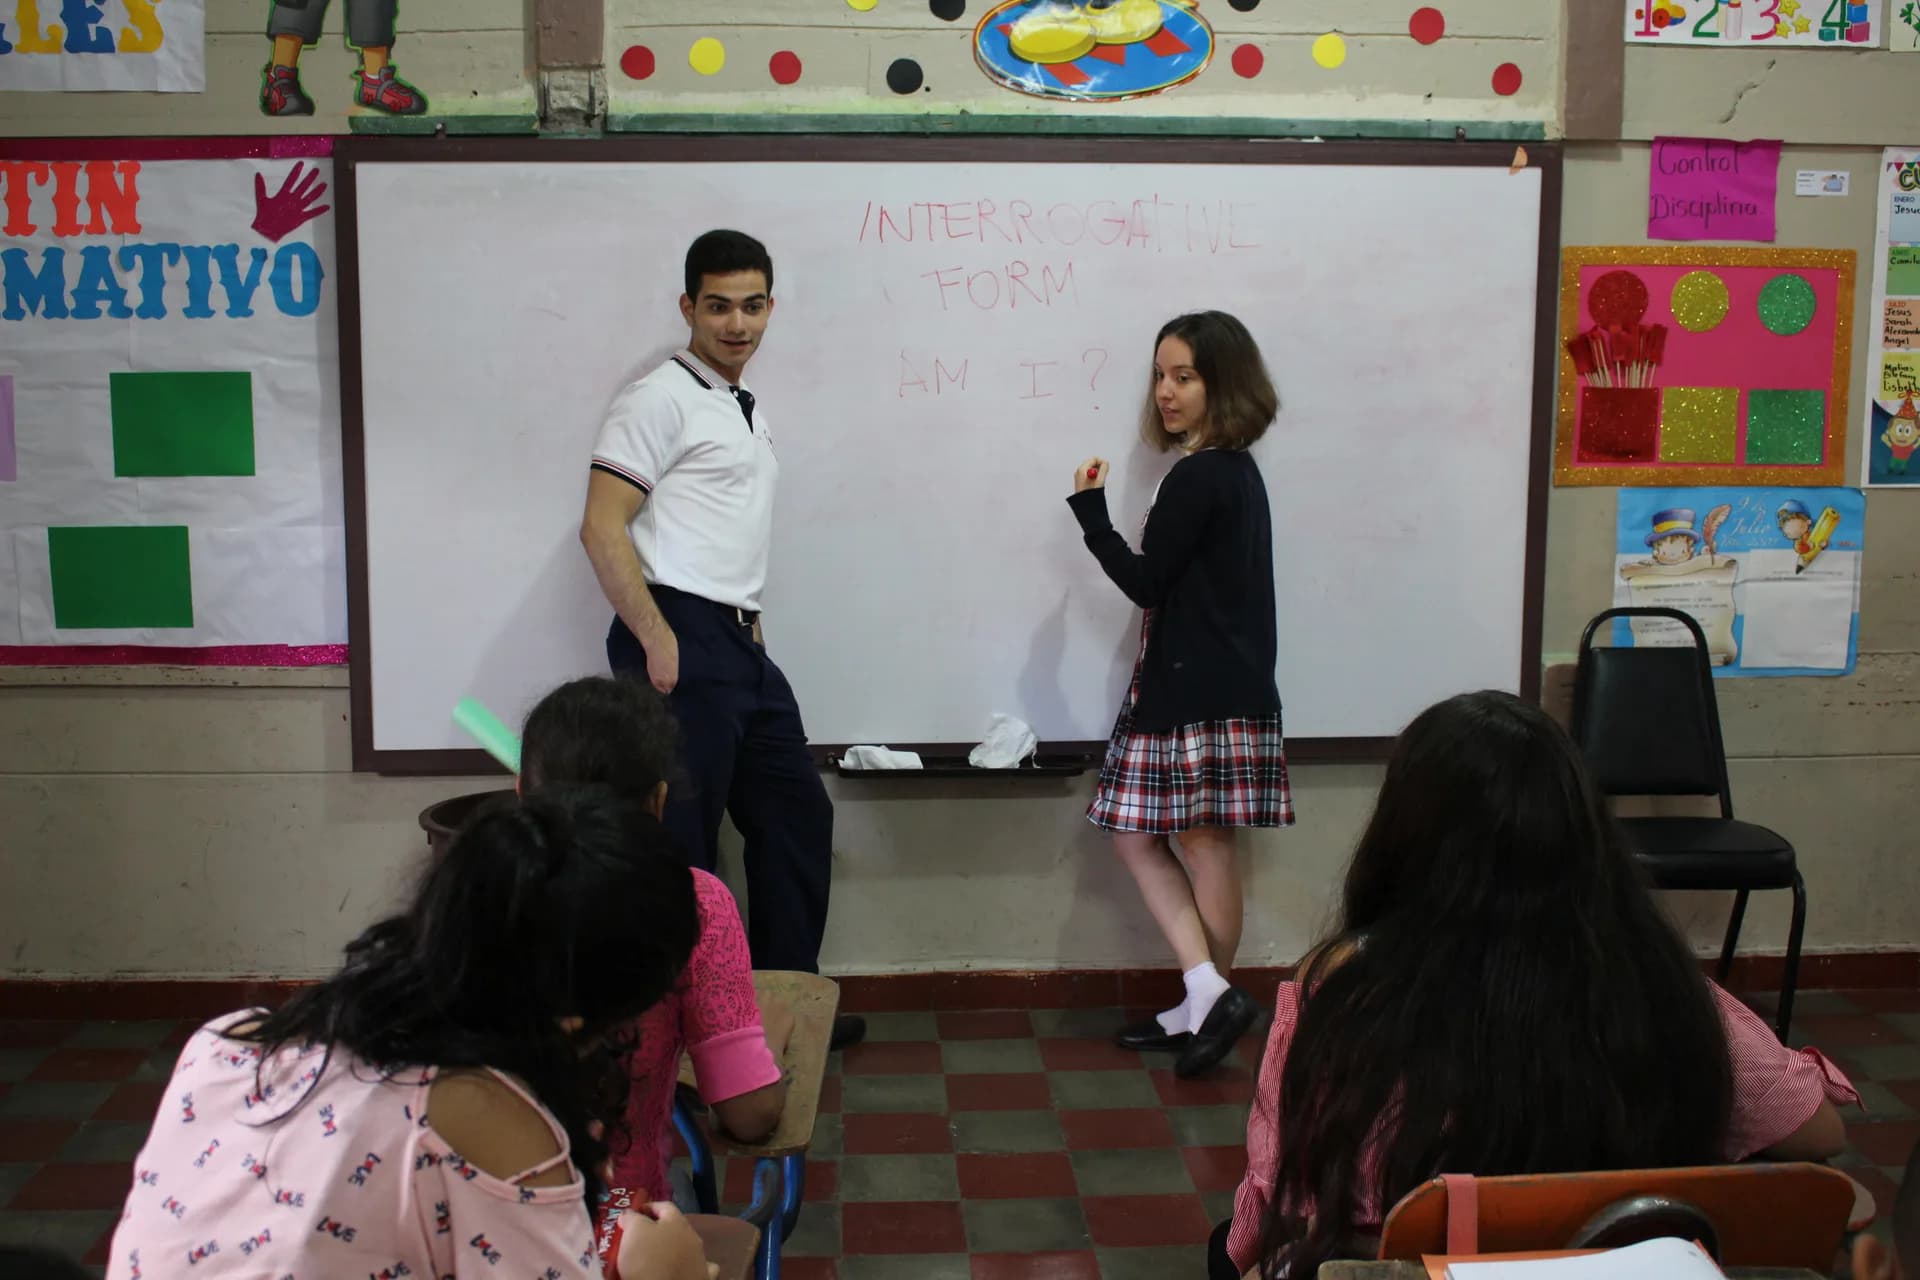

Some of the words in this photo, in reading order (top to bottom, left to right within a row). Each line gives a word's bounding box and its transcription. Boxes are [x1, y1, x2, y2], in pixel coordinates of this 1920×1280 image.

[0, 0, 164, 54] LES
[1635, 0, 1659, 36] 1
[1692, 0, 1720, 38] 2
[1751, 0, 1780, 40] 3
[1821, 0, 1850, 40] 4
[1658, 140, 1739, 175] Control
[0, 161, 142, 237] TIN
[858, 193, 1262, 254] INTERROGATIVE
[1650, 192, 1757, 230] Disciplina
[920, 260, 1079, 311] FORM
[899, 350, 968, 398] AM
